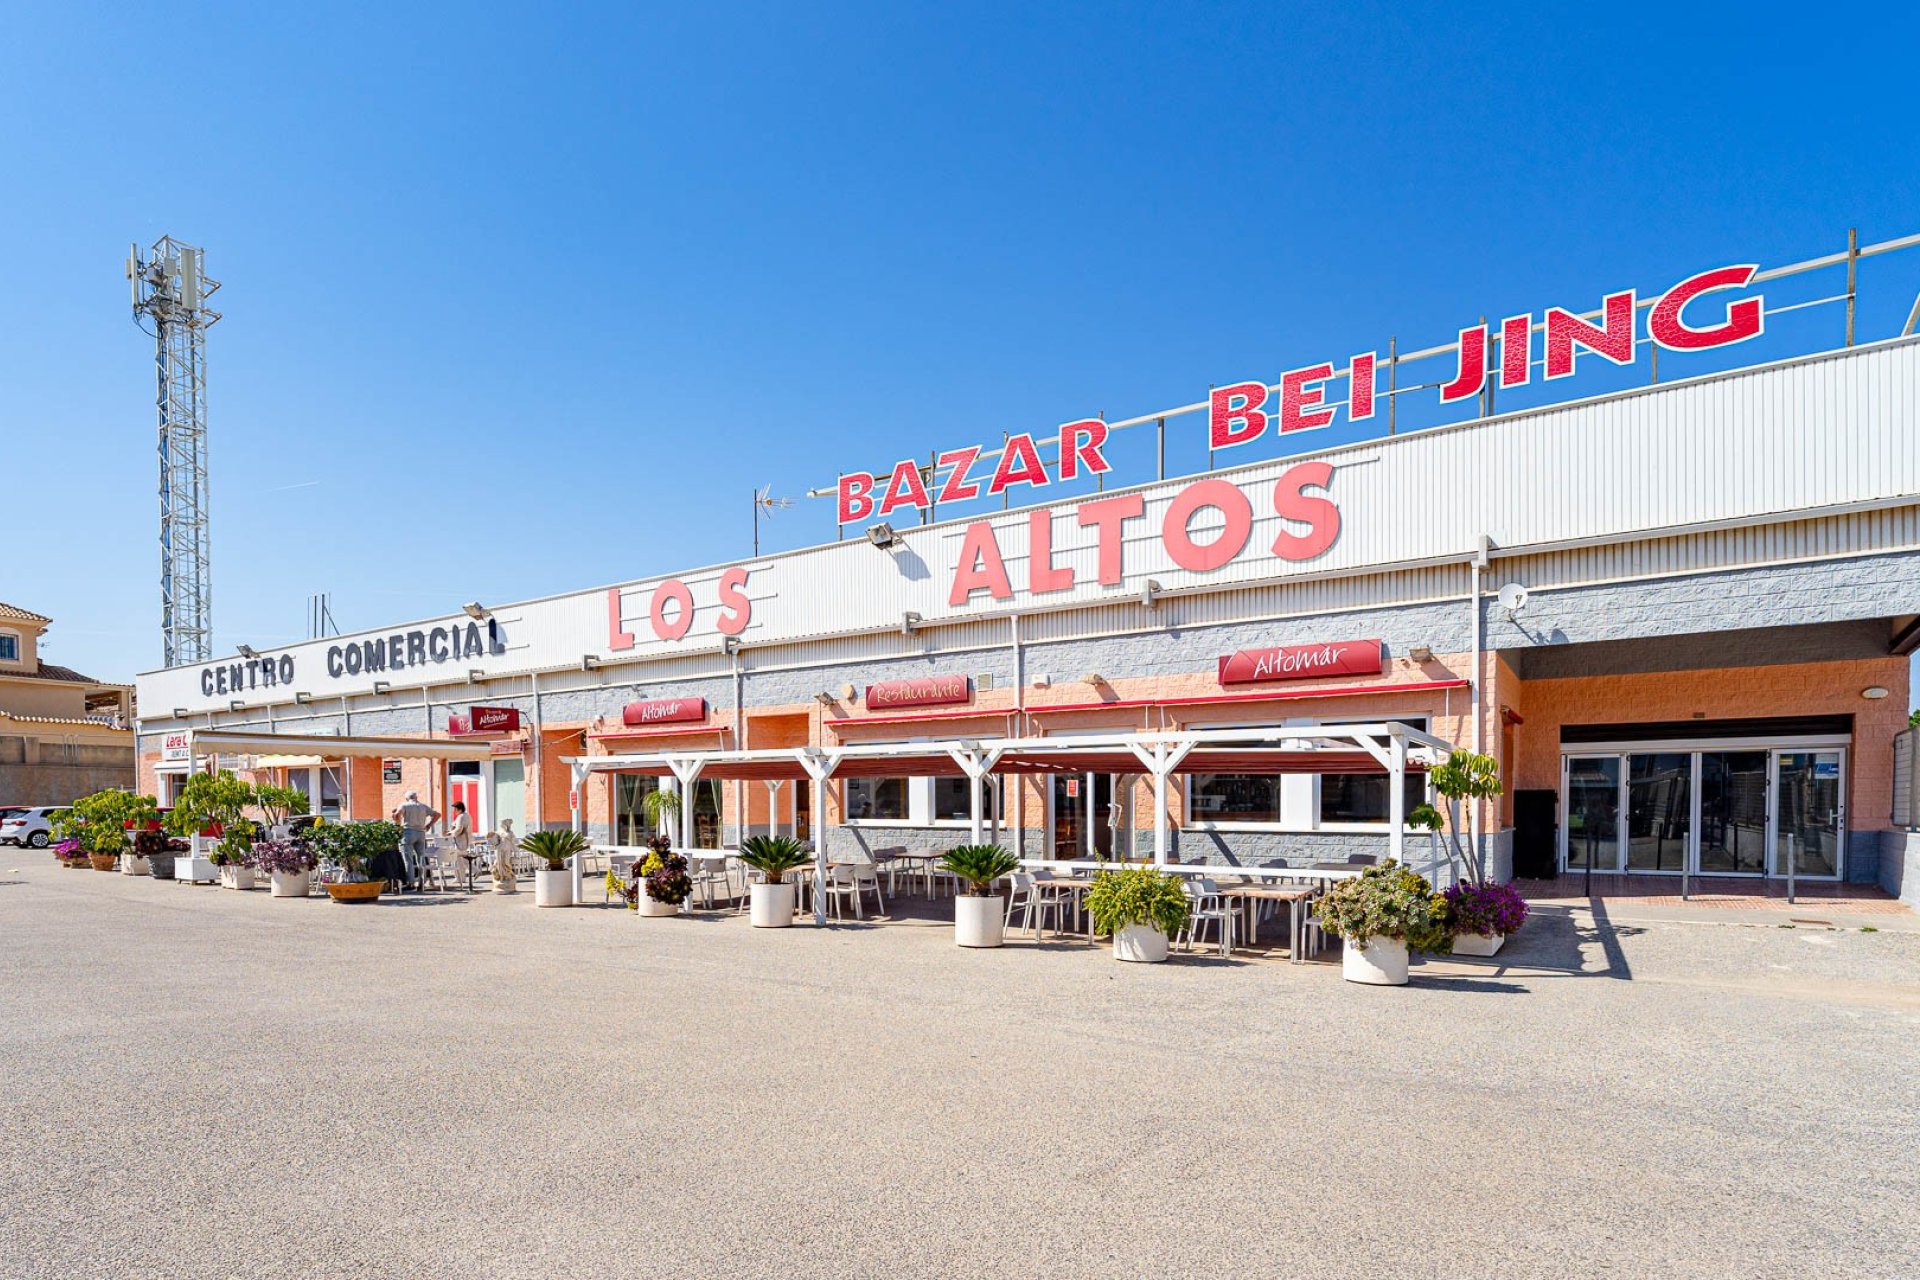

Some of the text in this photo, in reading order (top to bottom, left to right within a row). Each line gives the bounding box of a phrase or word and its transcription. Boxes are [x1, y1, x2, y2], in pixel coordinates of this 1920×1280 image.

[838, 263, 1764, 525] BAZAR BEI JING
[201, 461, 1340, 696] CENTRO COMERCIAL LOS ALTOS
[1254, 646, 1347, 679] Altomar
[877, 680, 960, 702] Restaurante
[641, 702, 682, 722] Altomar
